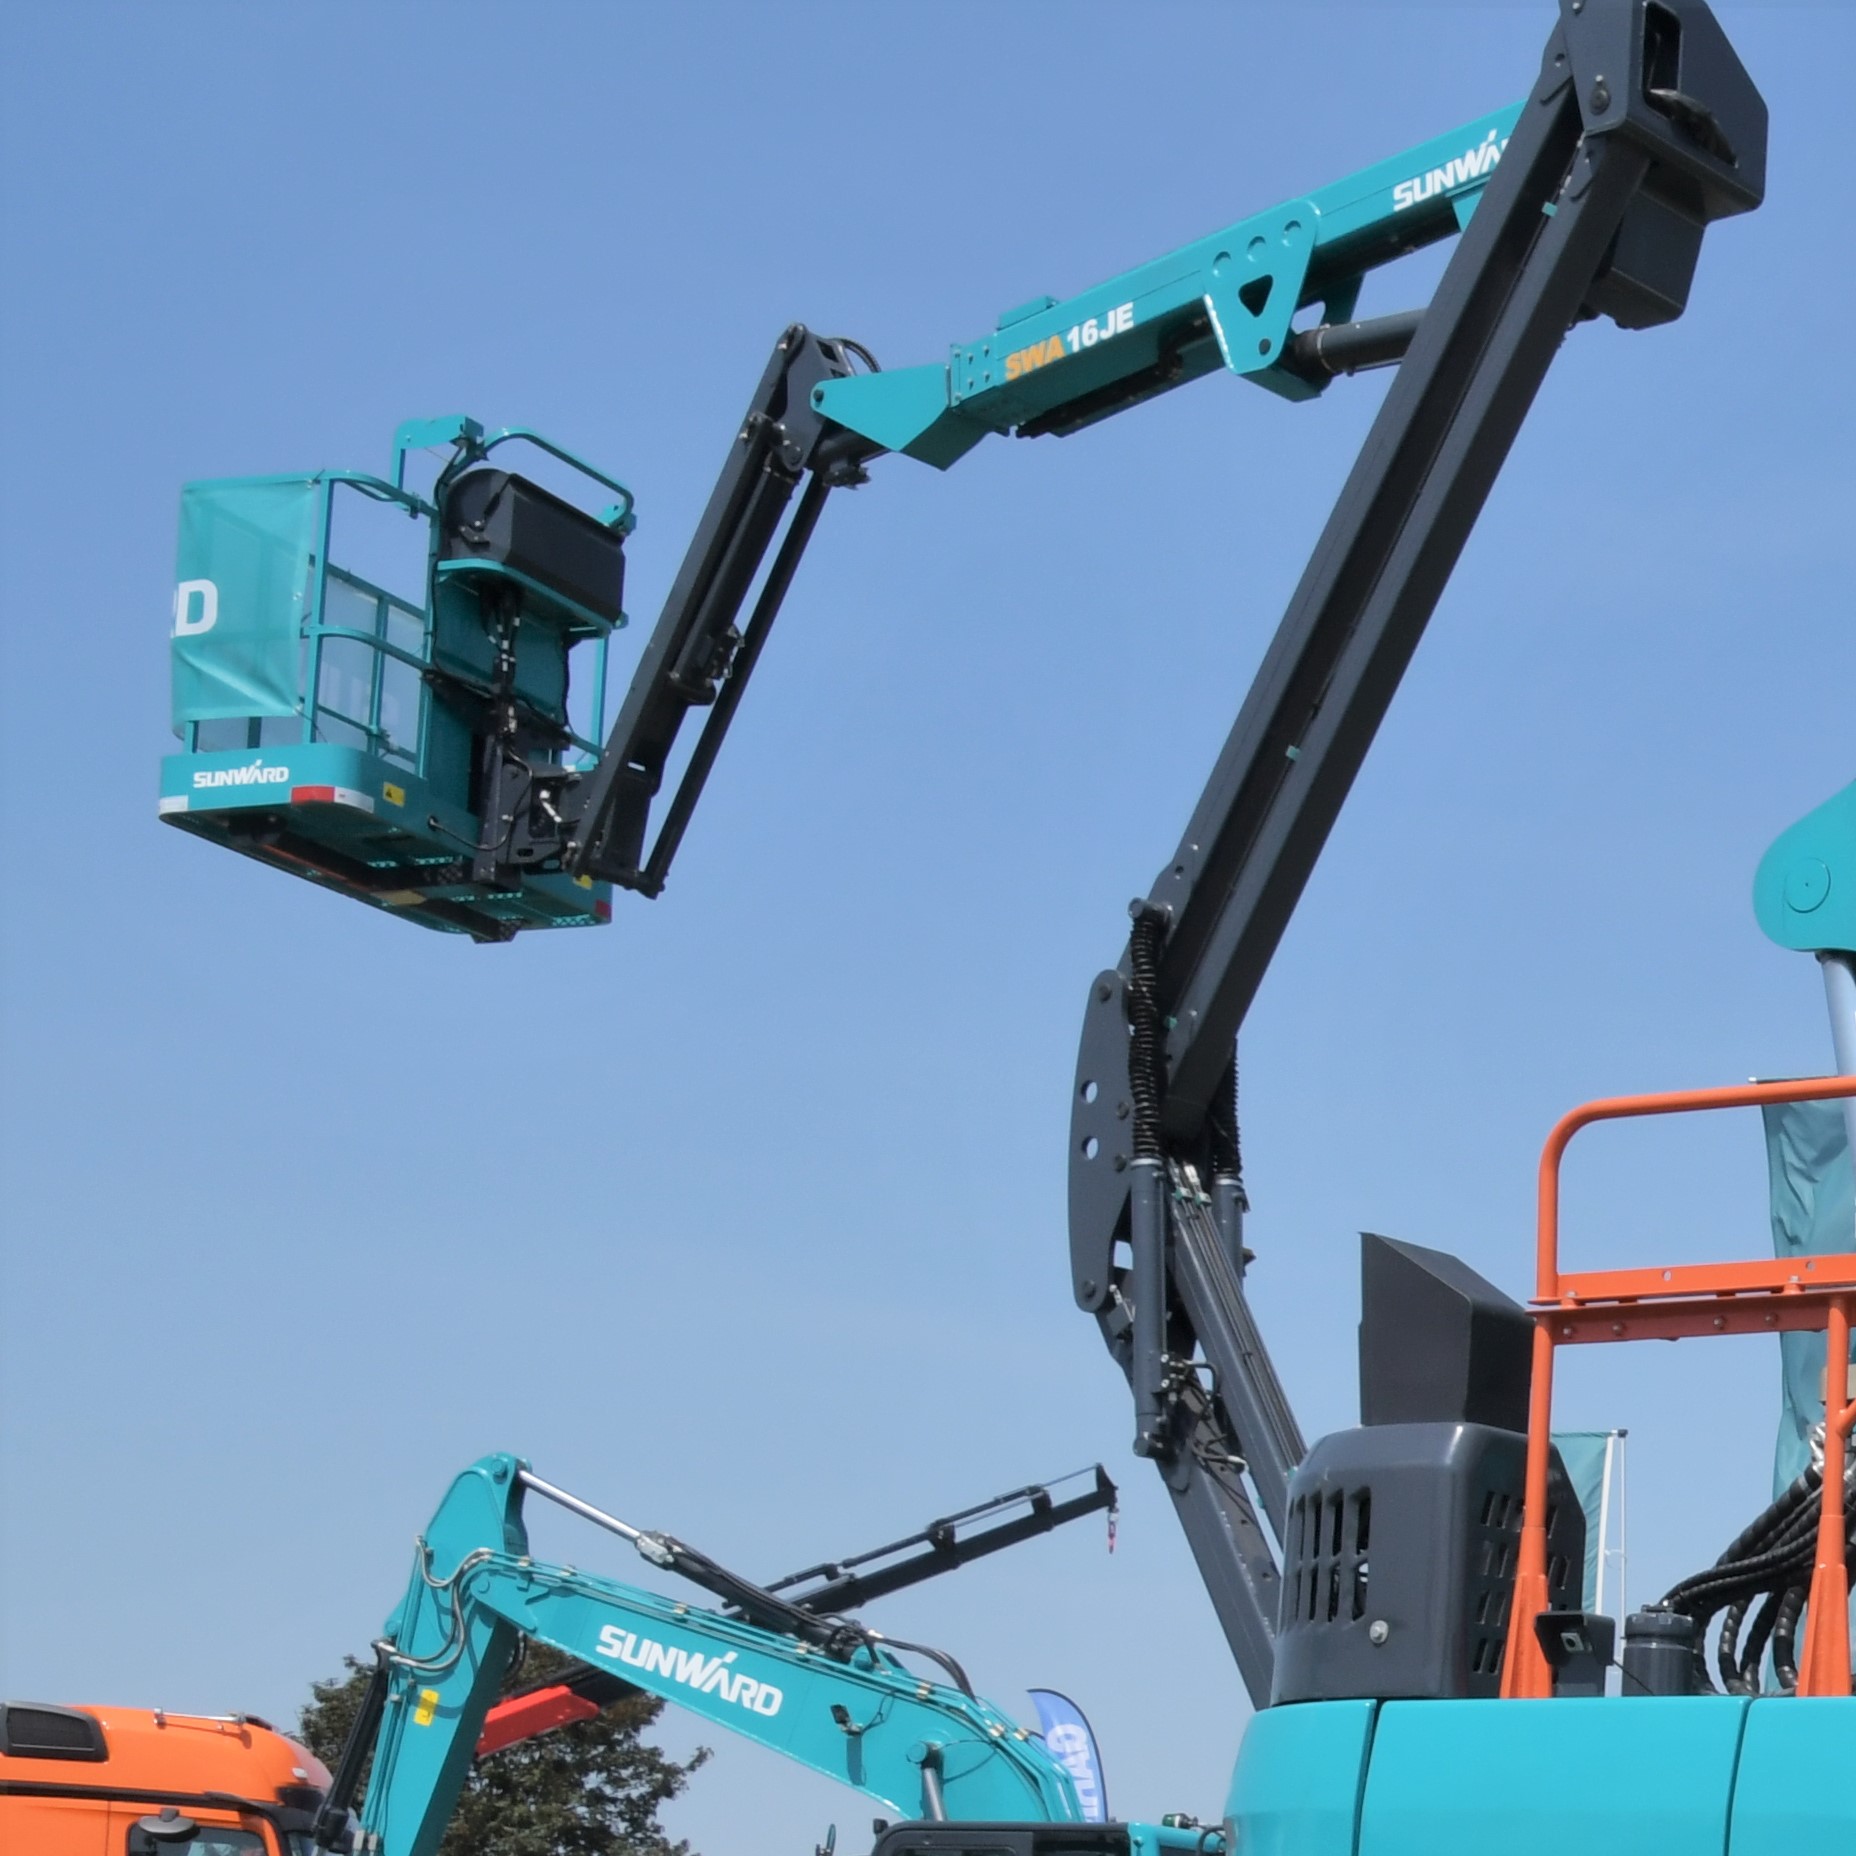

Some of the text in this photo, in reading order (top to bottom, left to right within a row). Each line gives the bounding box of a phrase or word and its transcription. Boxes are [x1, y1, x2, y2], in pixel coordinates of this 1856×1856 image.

[1393, 128, 1510, 211] SUNWA
[1005, 301, 1135, 381] SWA 16JE
[171, 578, 219, 638] D
[193, 759, 290, 788] SUNWARD
[595, 1624, 783, 1717] SUNWARD
